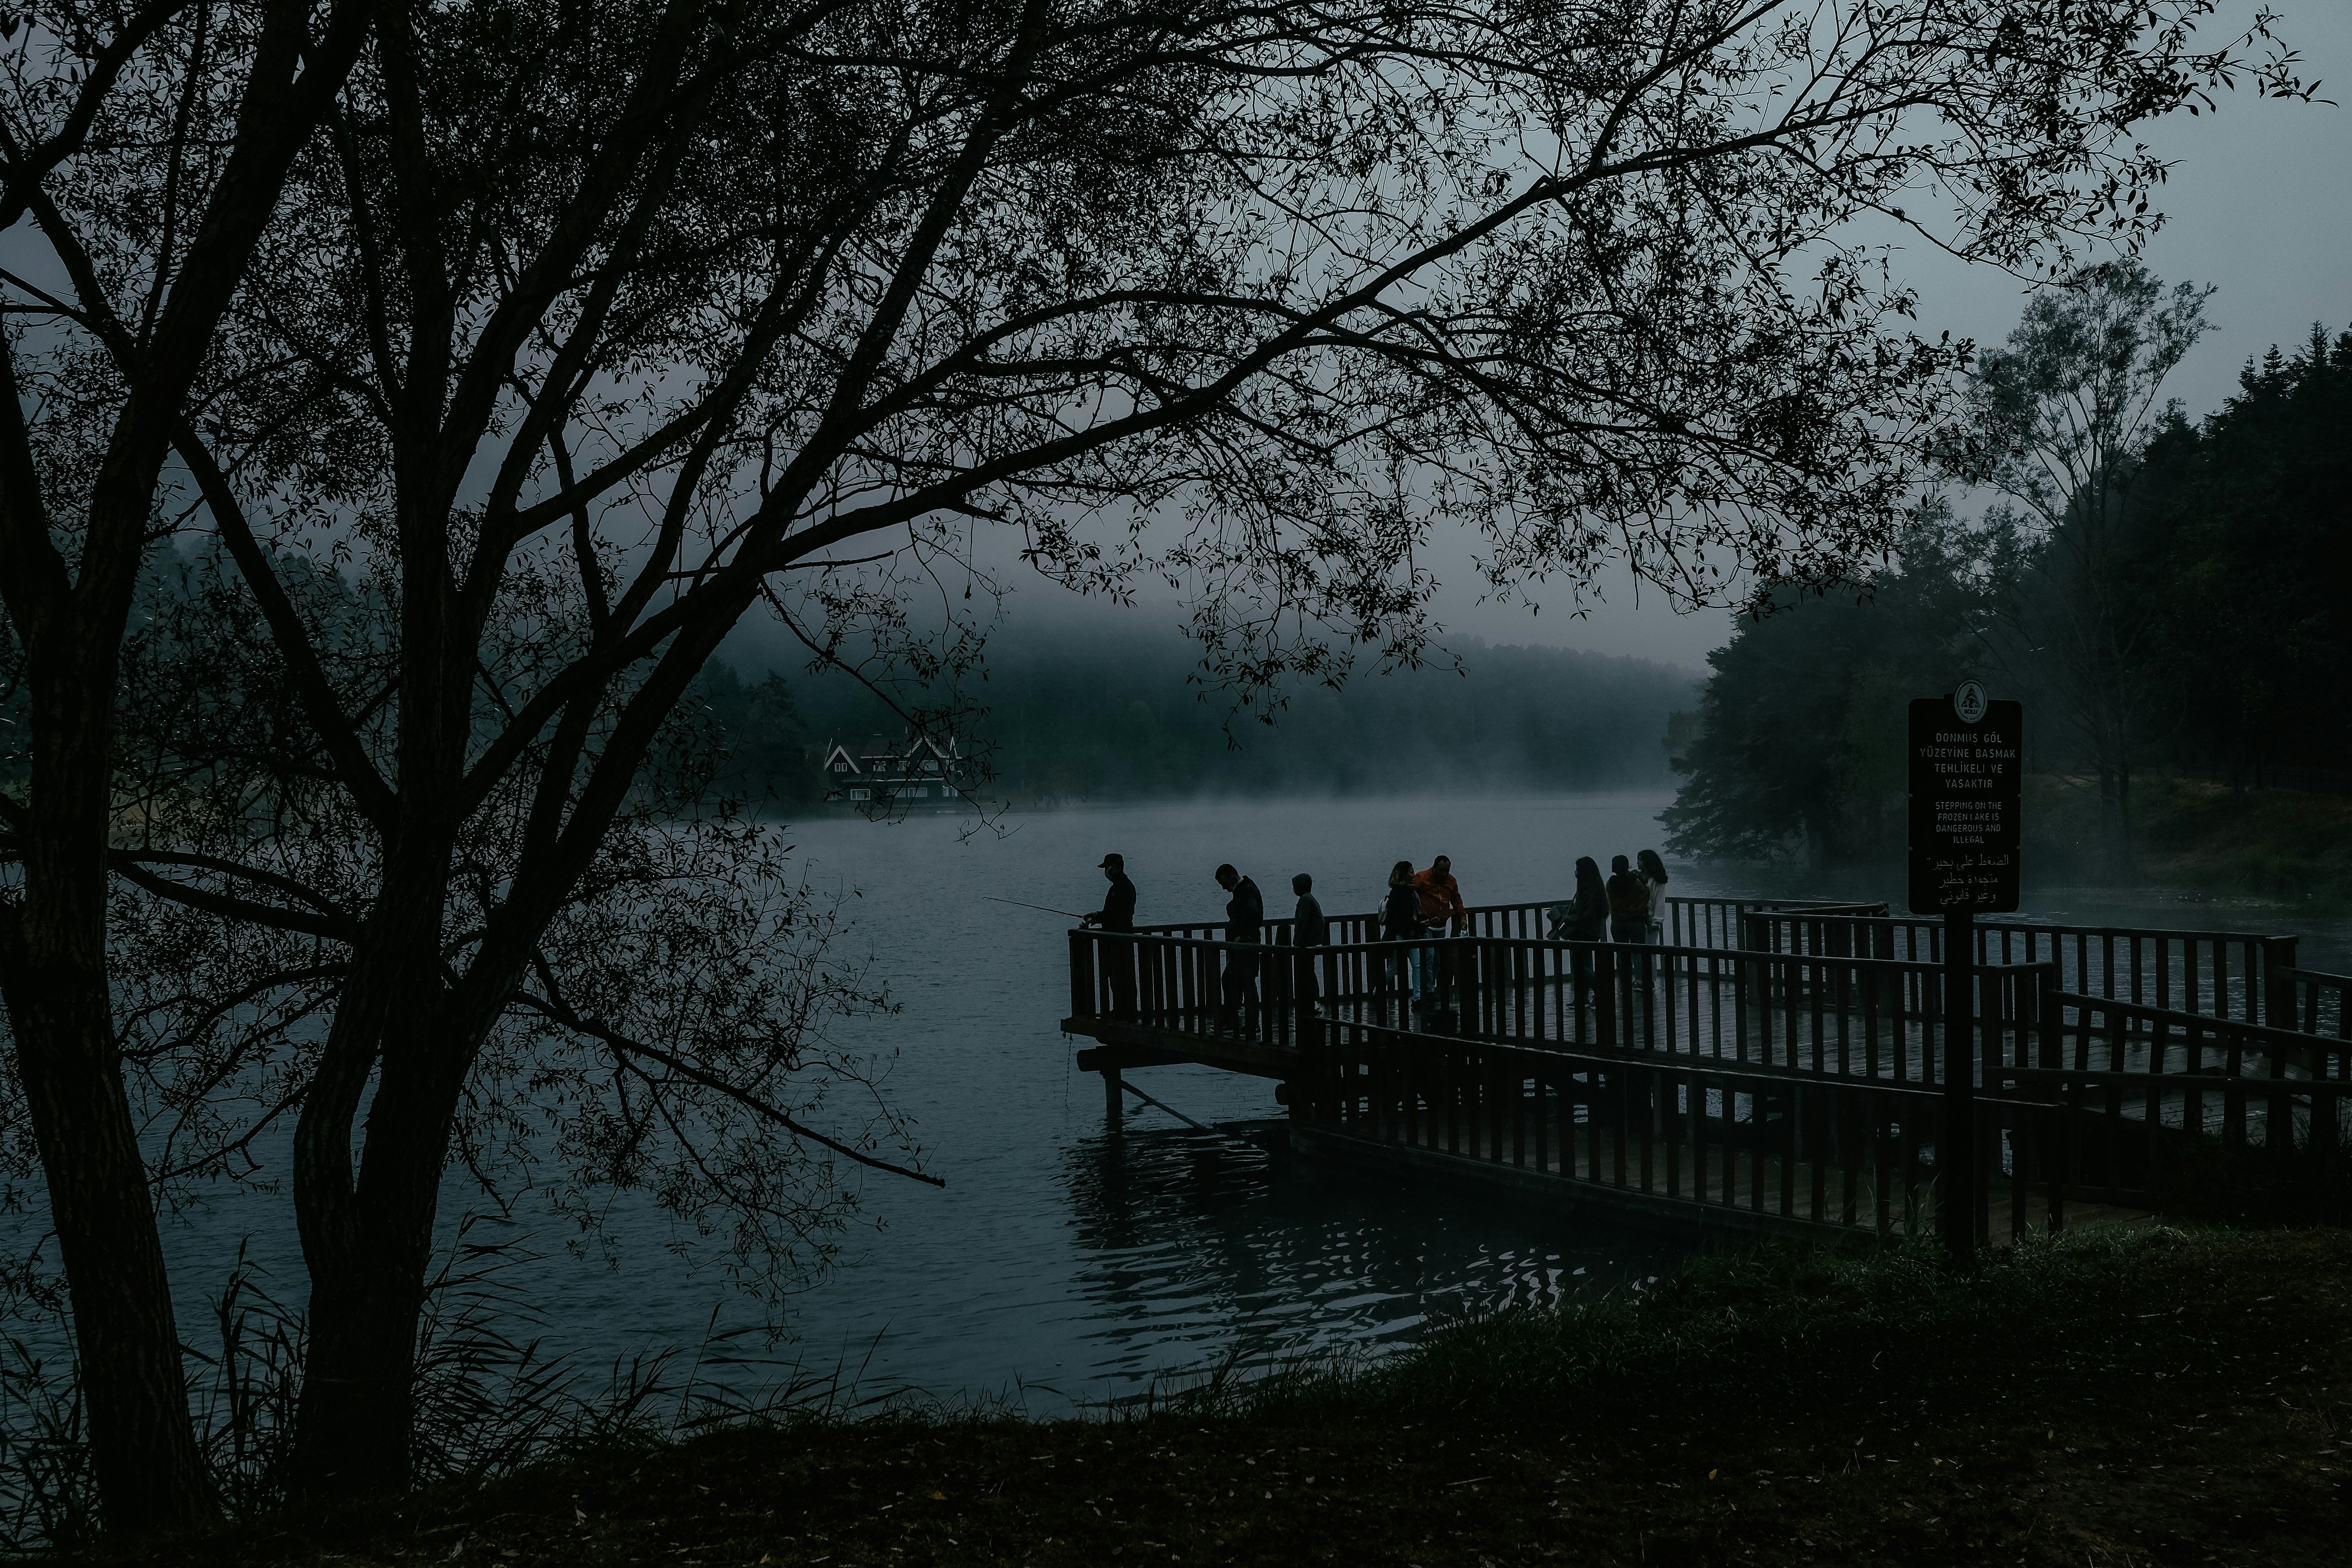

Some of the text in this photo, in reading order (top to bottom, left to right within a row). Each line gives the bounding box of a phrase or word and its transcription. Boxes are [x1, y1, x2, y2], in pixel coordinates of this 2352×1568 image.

[1936, 732, 2002, 745] DONMUŞ GÖL
[1921, 746, 2015, 758] YÜZEYİNE BASMAK
[1991, 765, 2002, 773] VE
[1946, 780, 1992, 788] YASAKTIR
[1979, 854, 2008, 865] الضغط
[1939, 872, 1963, 888] خطير
[1940, 888, 1969, 907] قانوني
